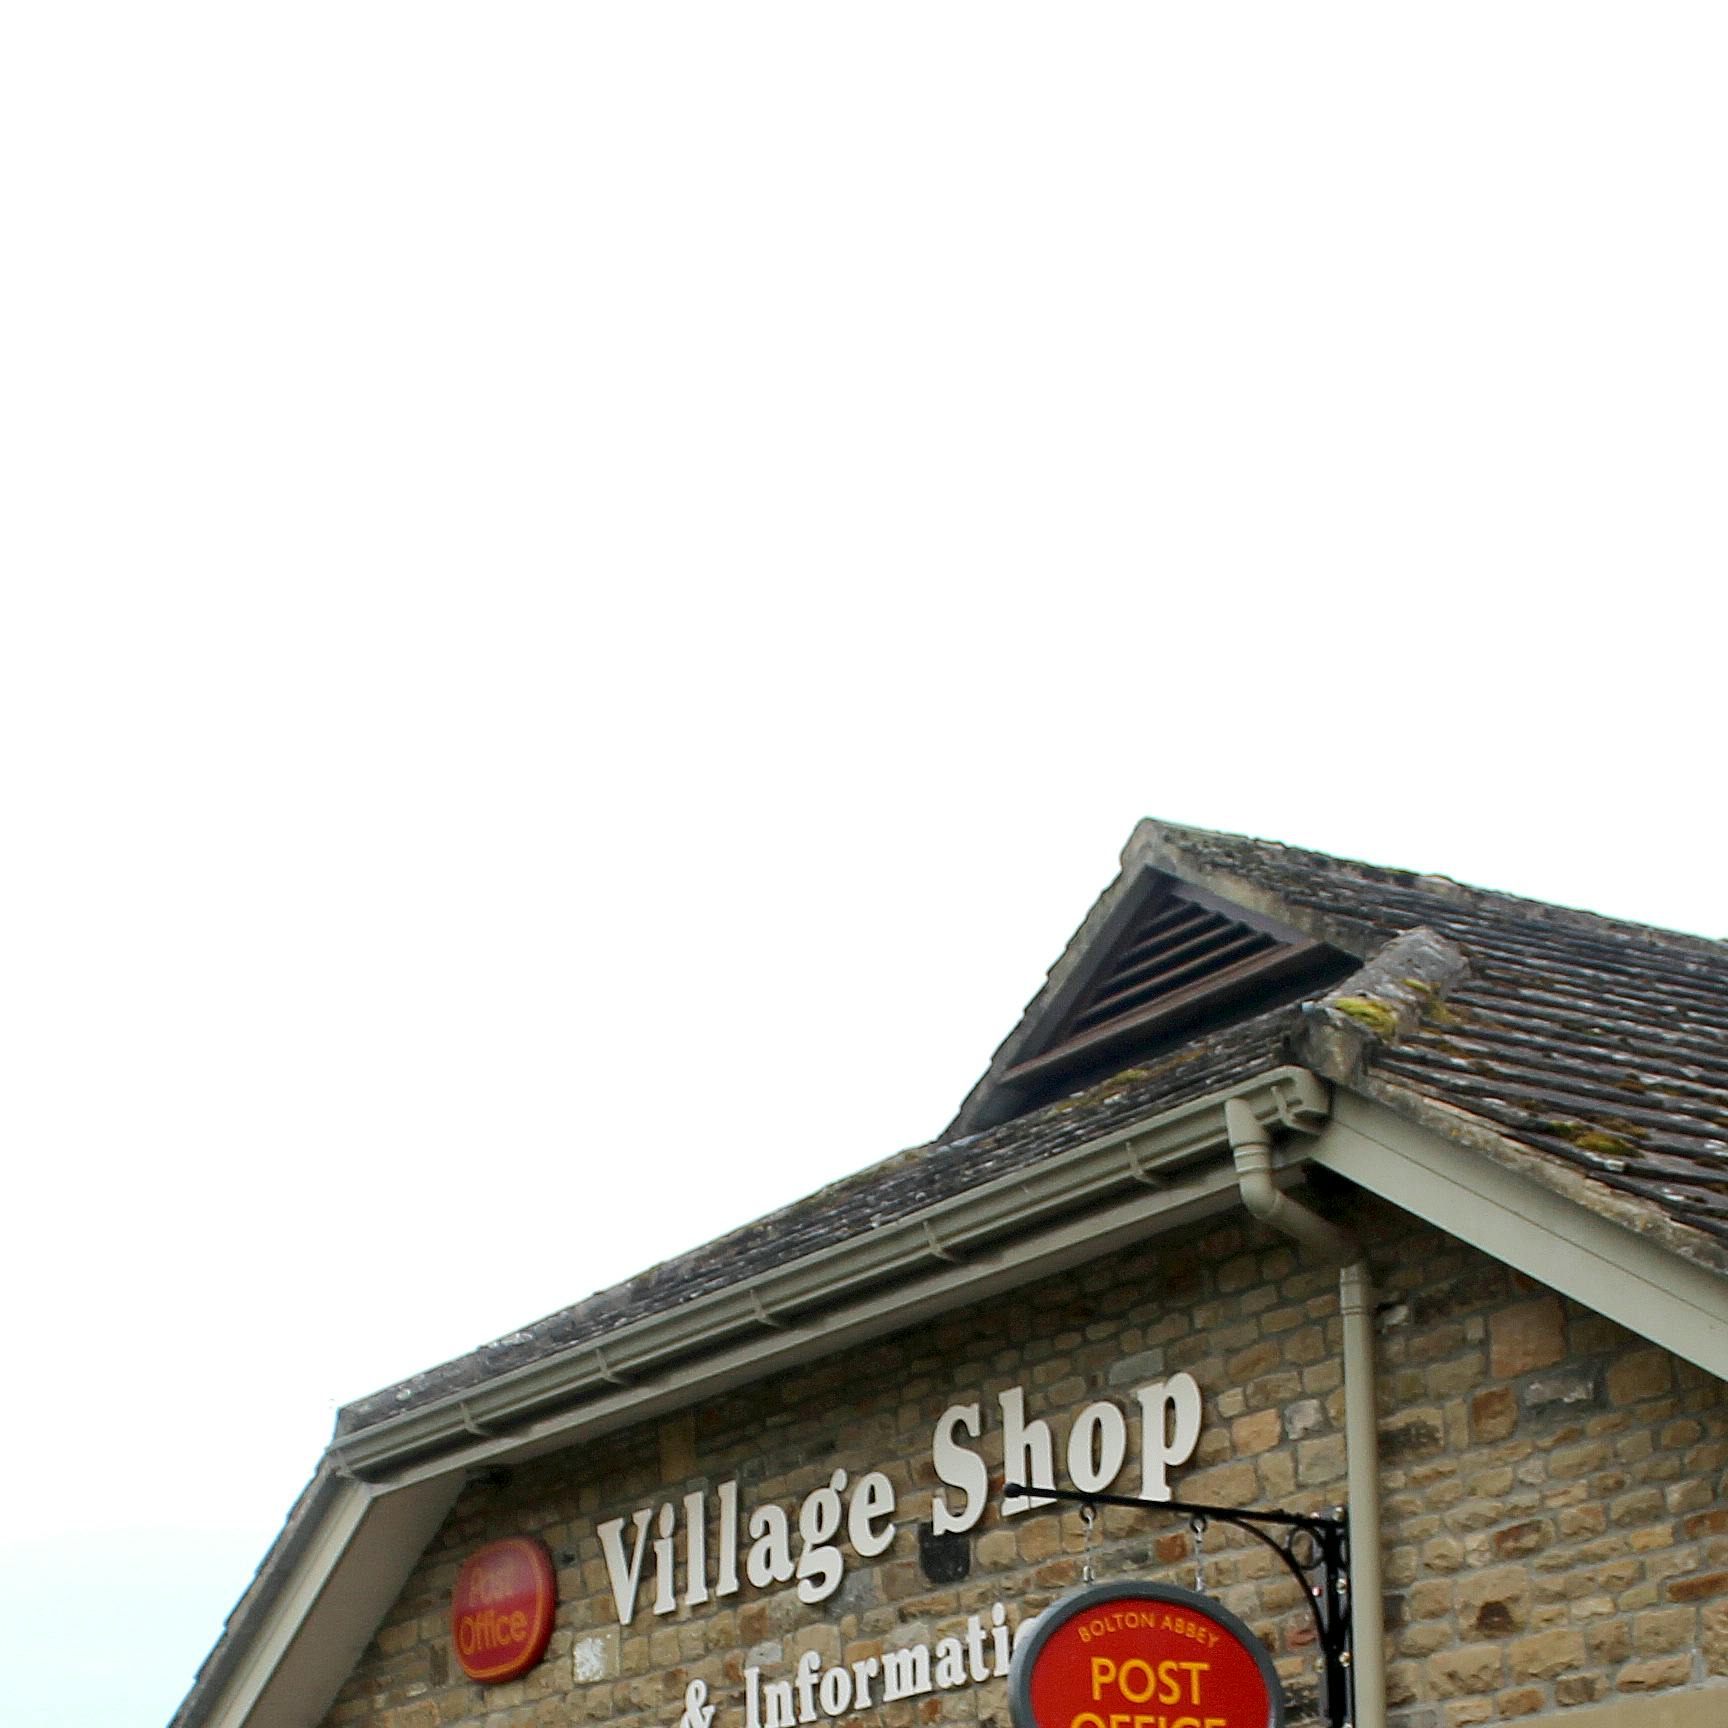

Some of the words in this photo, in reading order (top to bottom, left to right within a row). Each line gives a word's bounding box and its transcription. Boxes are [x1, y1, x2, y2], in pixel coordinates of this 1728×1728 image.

[597, 1468, 897, 1626] Village
[932, 1372, 1202, 1537] Shop
[460, 1609, 528, 1655] Office
[1078, 1611, 1155, 1643] BOLTON
[1160, 1615, 1220, 1648] ABBEY
[1090, 1656, 1211, 1706] POST
